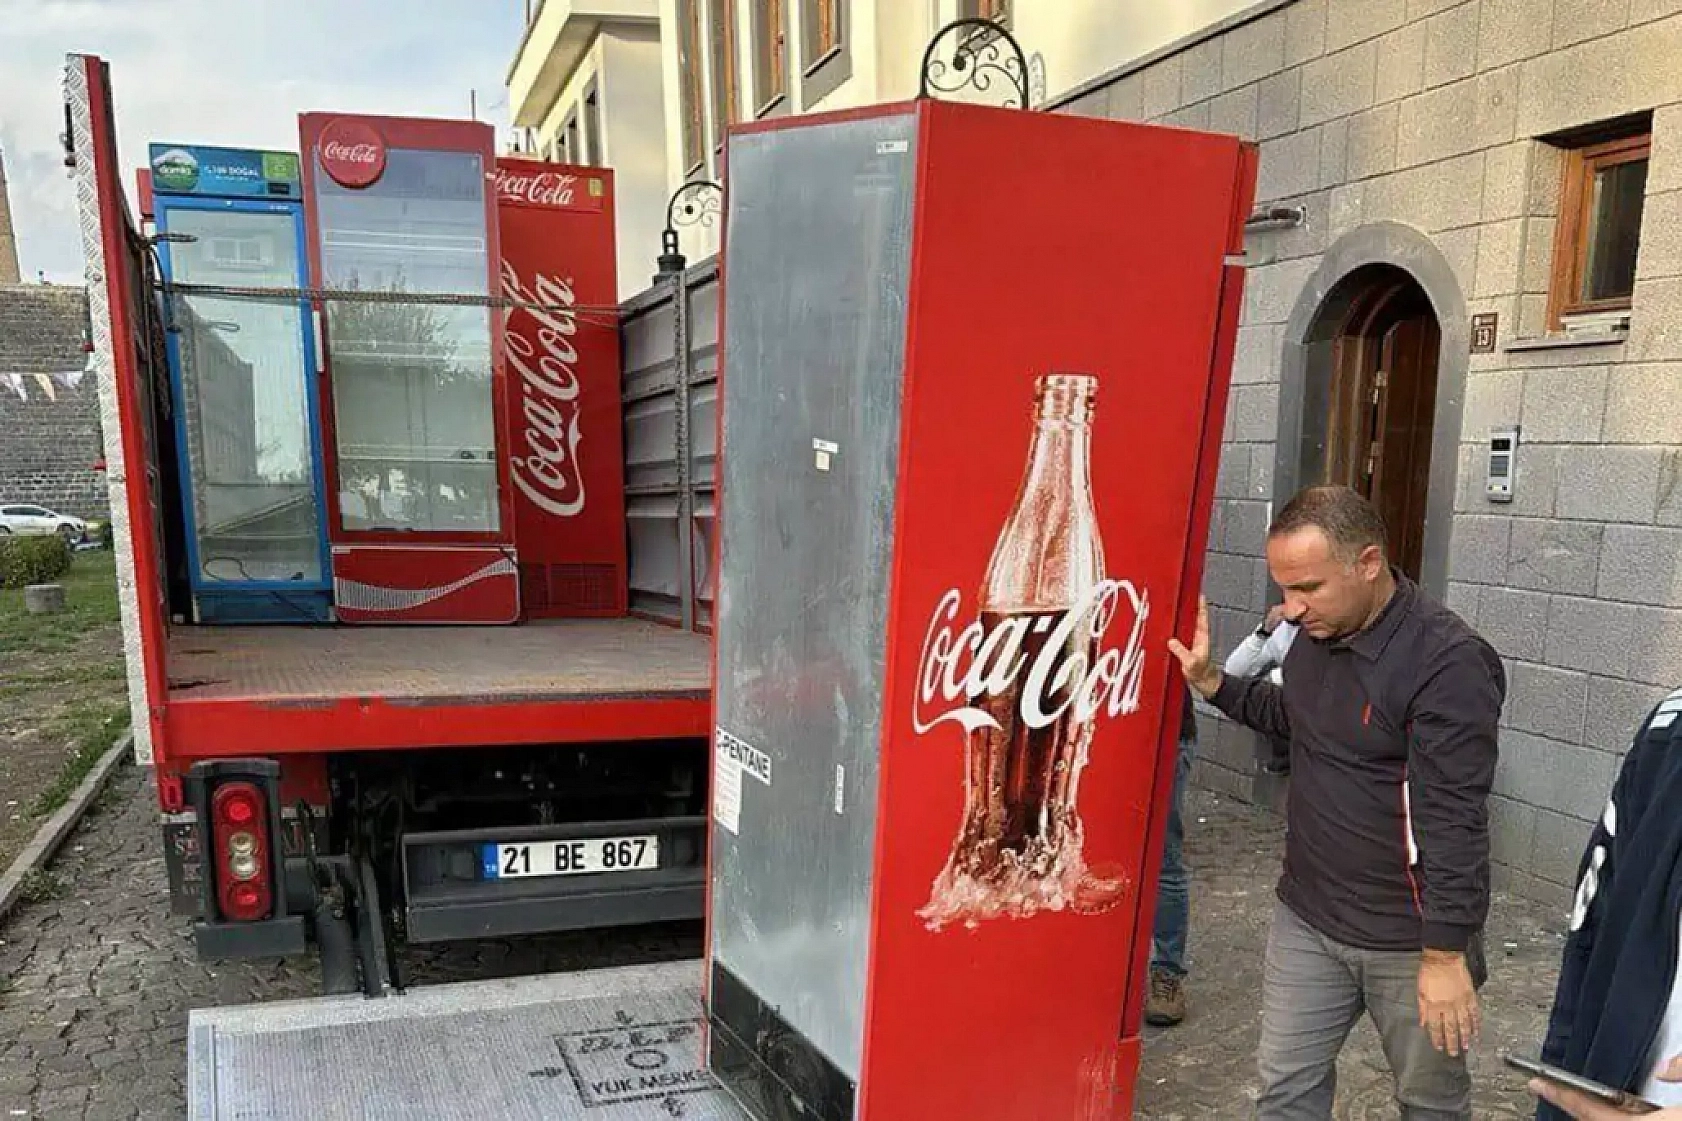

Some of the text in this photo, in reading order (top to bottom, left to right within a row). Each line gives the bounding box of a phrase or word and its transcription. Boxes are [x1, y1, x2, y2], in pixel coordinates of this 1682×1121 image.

[496, 168, 578, 205] oca-Cola
[504, 839, 647, 874] 21 BE 867
